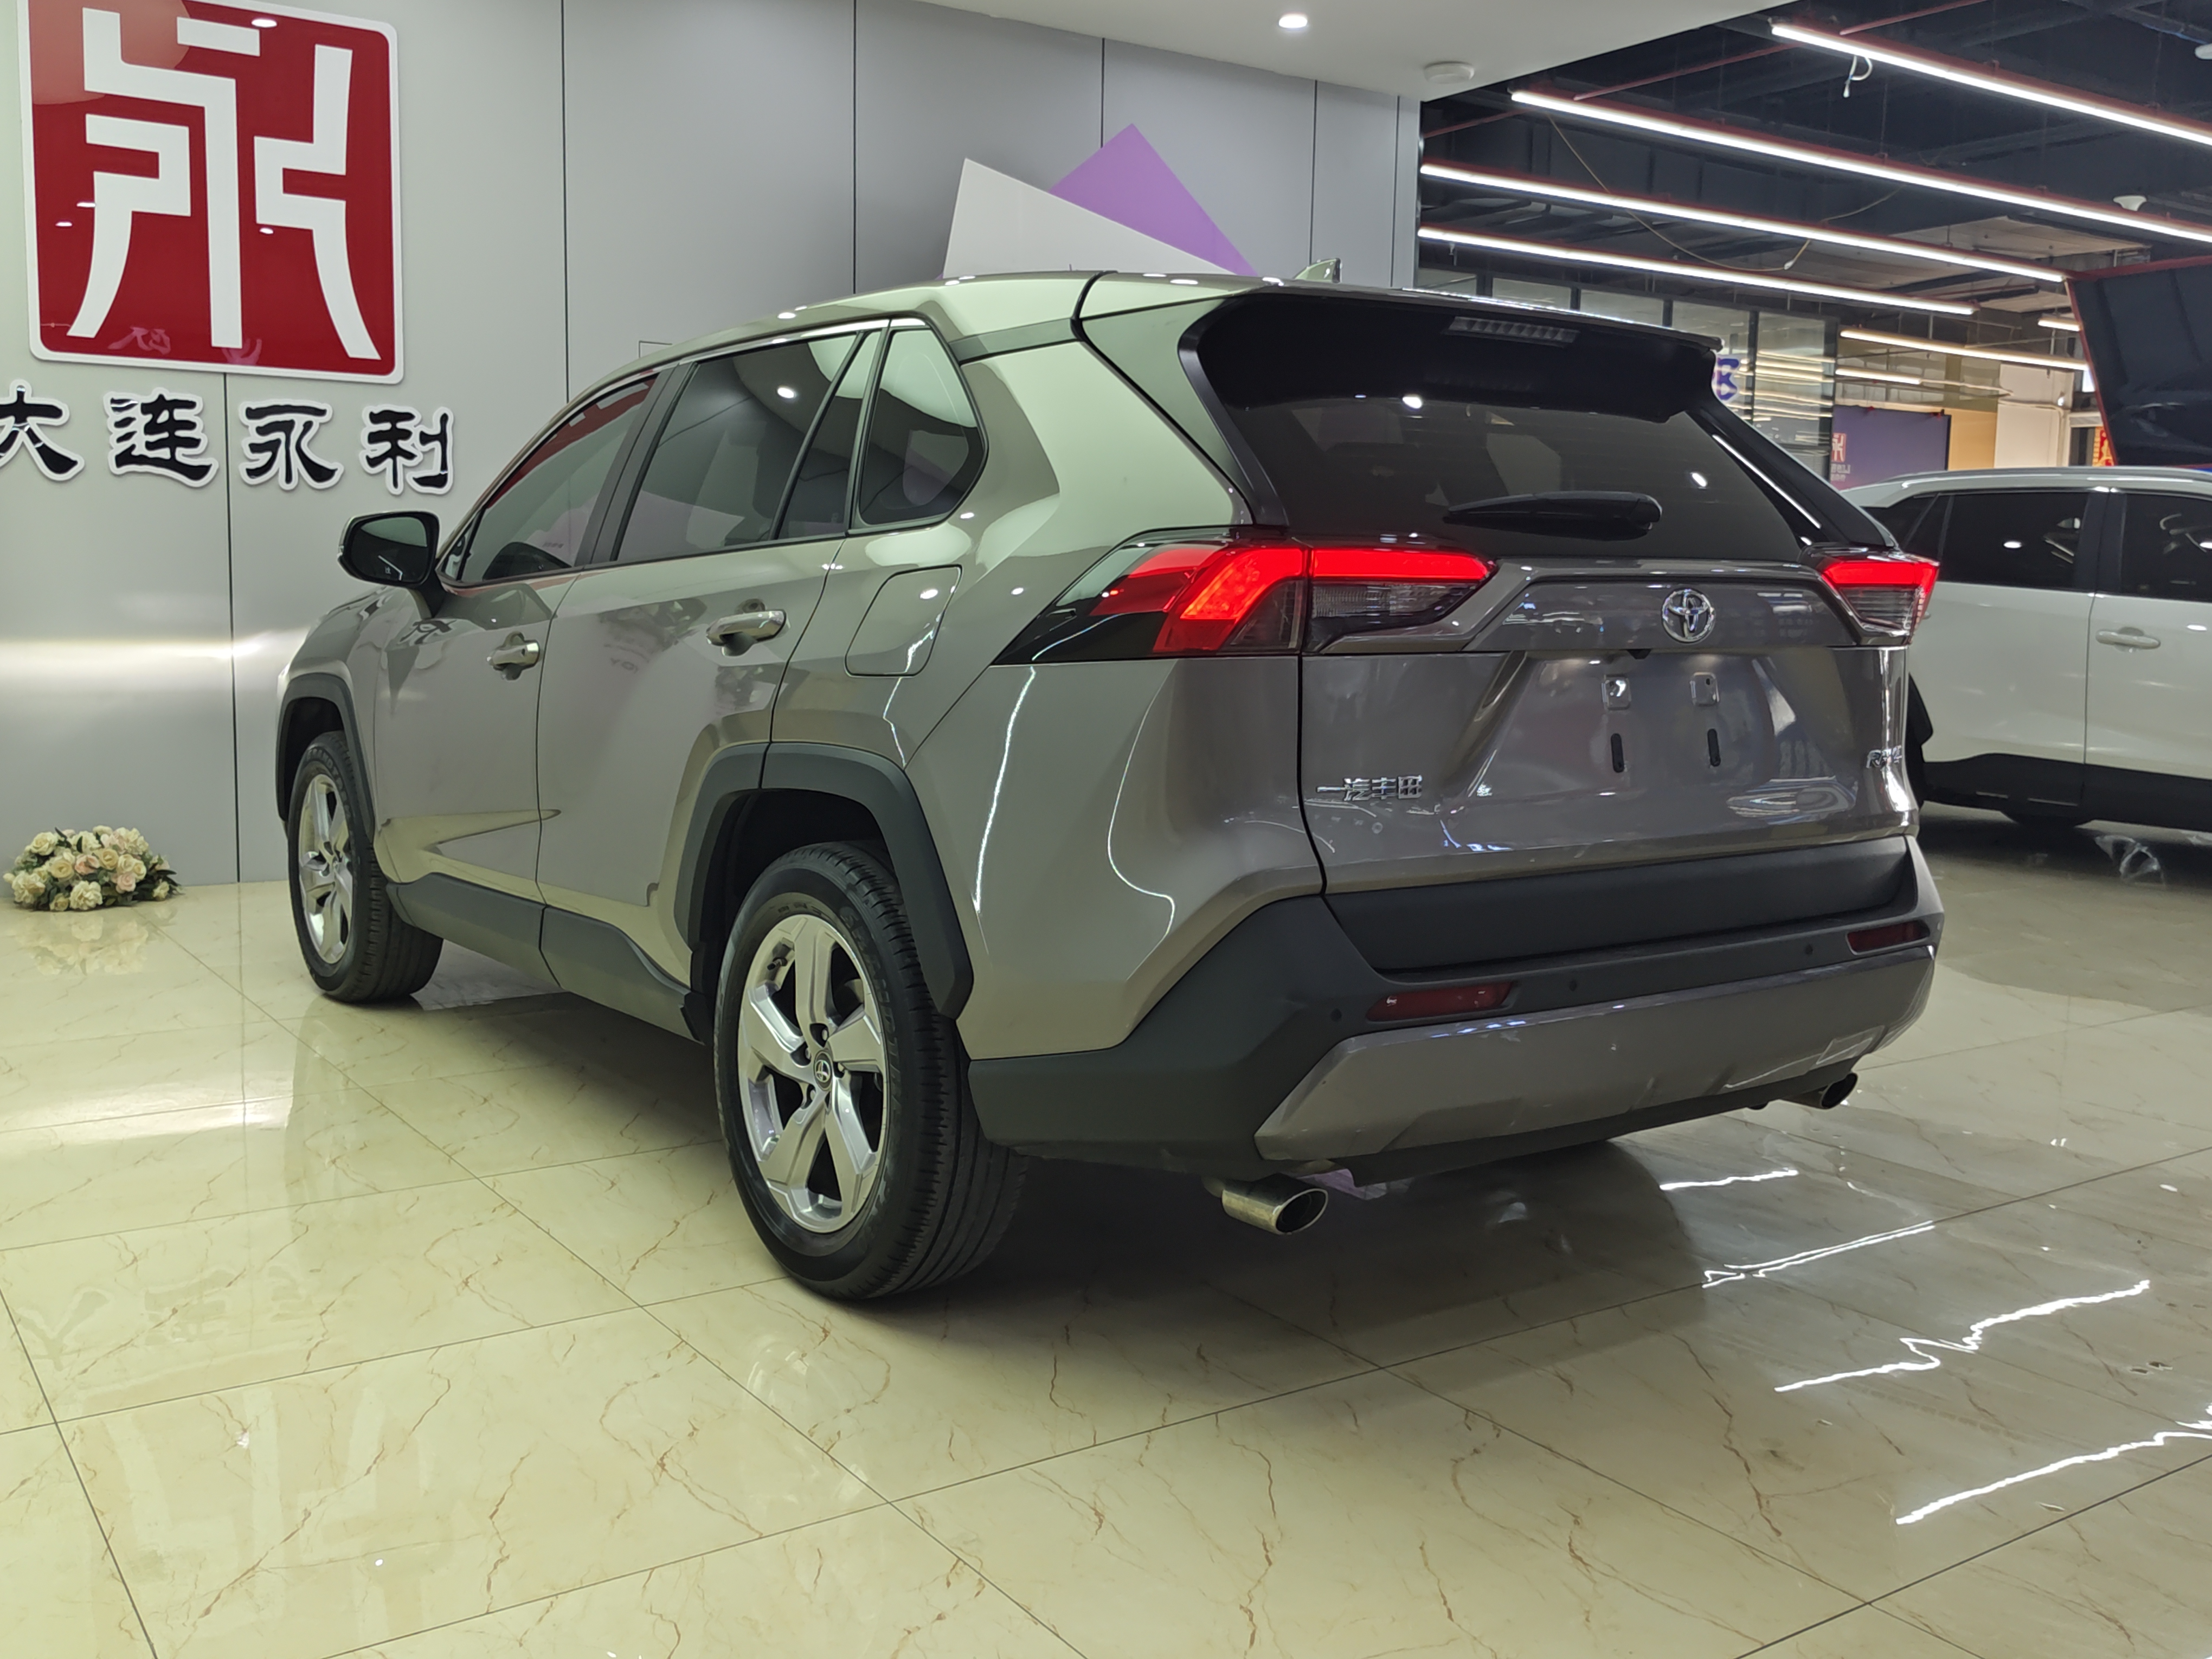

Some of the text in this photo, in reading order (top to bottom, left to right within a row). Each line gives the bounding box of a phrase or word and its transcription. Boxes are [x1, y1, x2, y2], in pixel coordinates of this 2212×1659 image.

[0, 385, 451, 490] 大连永利
[1316, 775, 1422, 801] 一汽丰田
